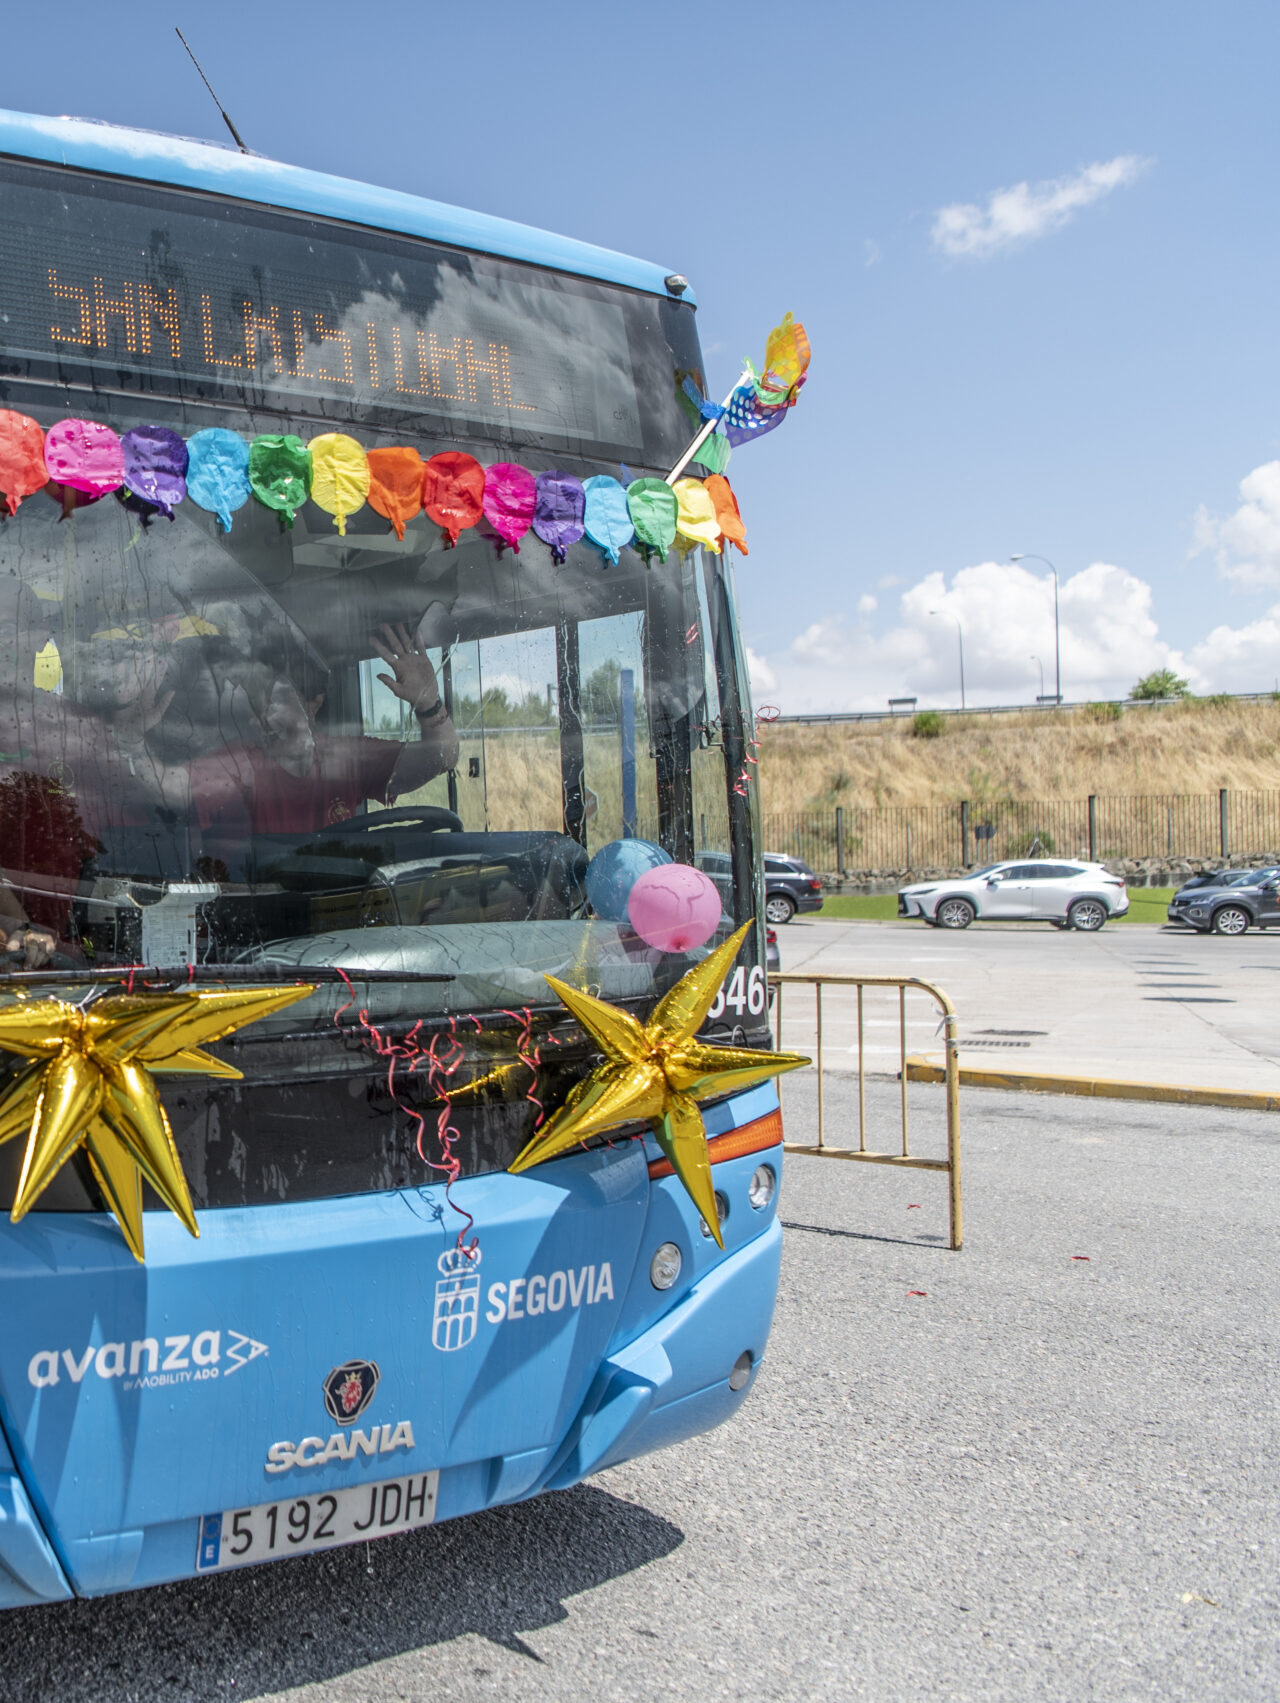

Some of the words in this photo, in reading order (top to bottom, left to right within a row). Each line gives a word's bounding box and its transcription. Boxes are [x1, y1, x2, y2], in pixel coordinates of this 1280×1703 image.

[485, 1261, 615, 1324] SEGOVIA
[27, 1329, 221, 1388] avanza
[134, 1371, 192, 1389] MOBILITY
[193, 1367, 219, 1380] ADO
[264, 1420, 415, 1474] SCANIA
[230, 1494, 339, 1556] 5192
[352, 1475, 429, 1531] JDH
[205, 1544, 215, 1560] E
